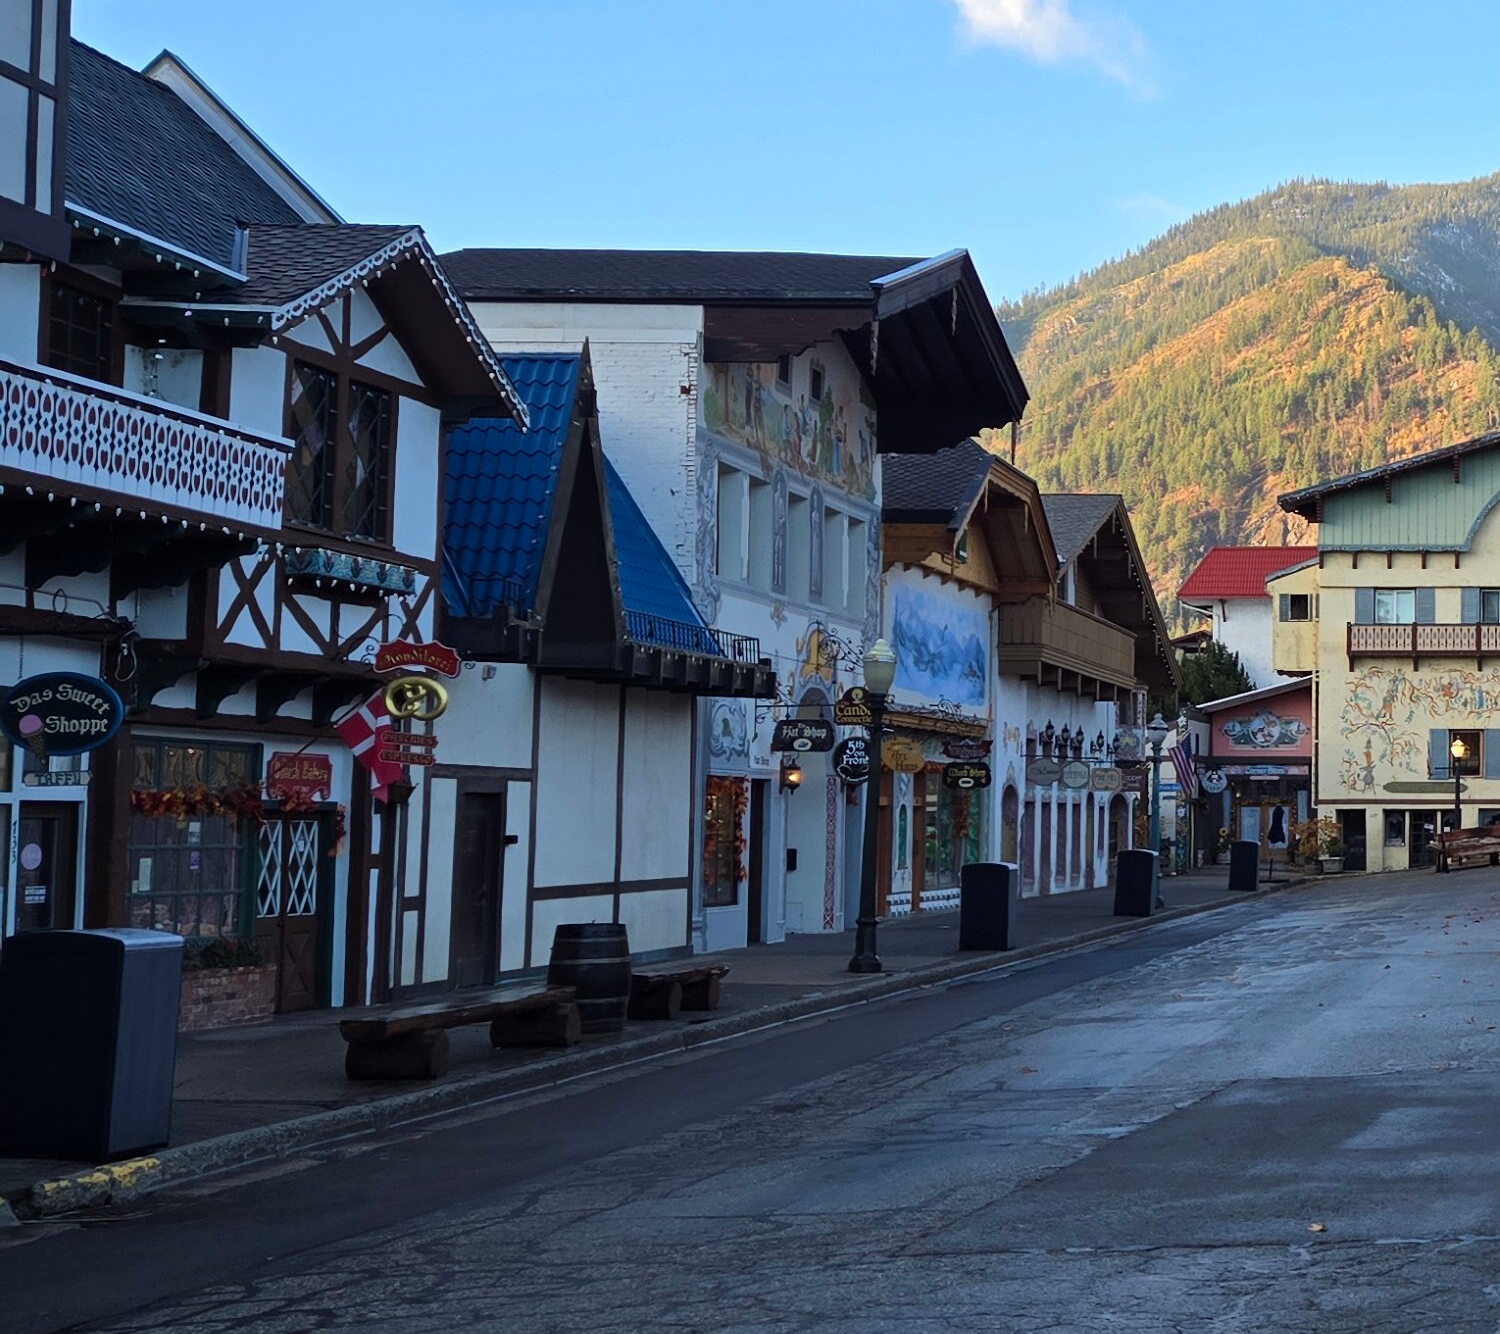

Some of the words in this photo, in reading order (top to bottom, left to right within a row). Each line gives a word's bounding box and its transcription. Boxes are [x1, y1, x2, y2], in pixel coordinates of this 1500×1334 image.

[9, 689, 53, 713] Das
[56, 683, 110, 715] Sweet
[44, 715, 108, 736] Shoppe
[802, 726, 827, 739] Shop
[846, 740, 865, 754] 5th
[381, 751, 431, 765] ESPRESSO
[843, 754, 870, 765] Front
